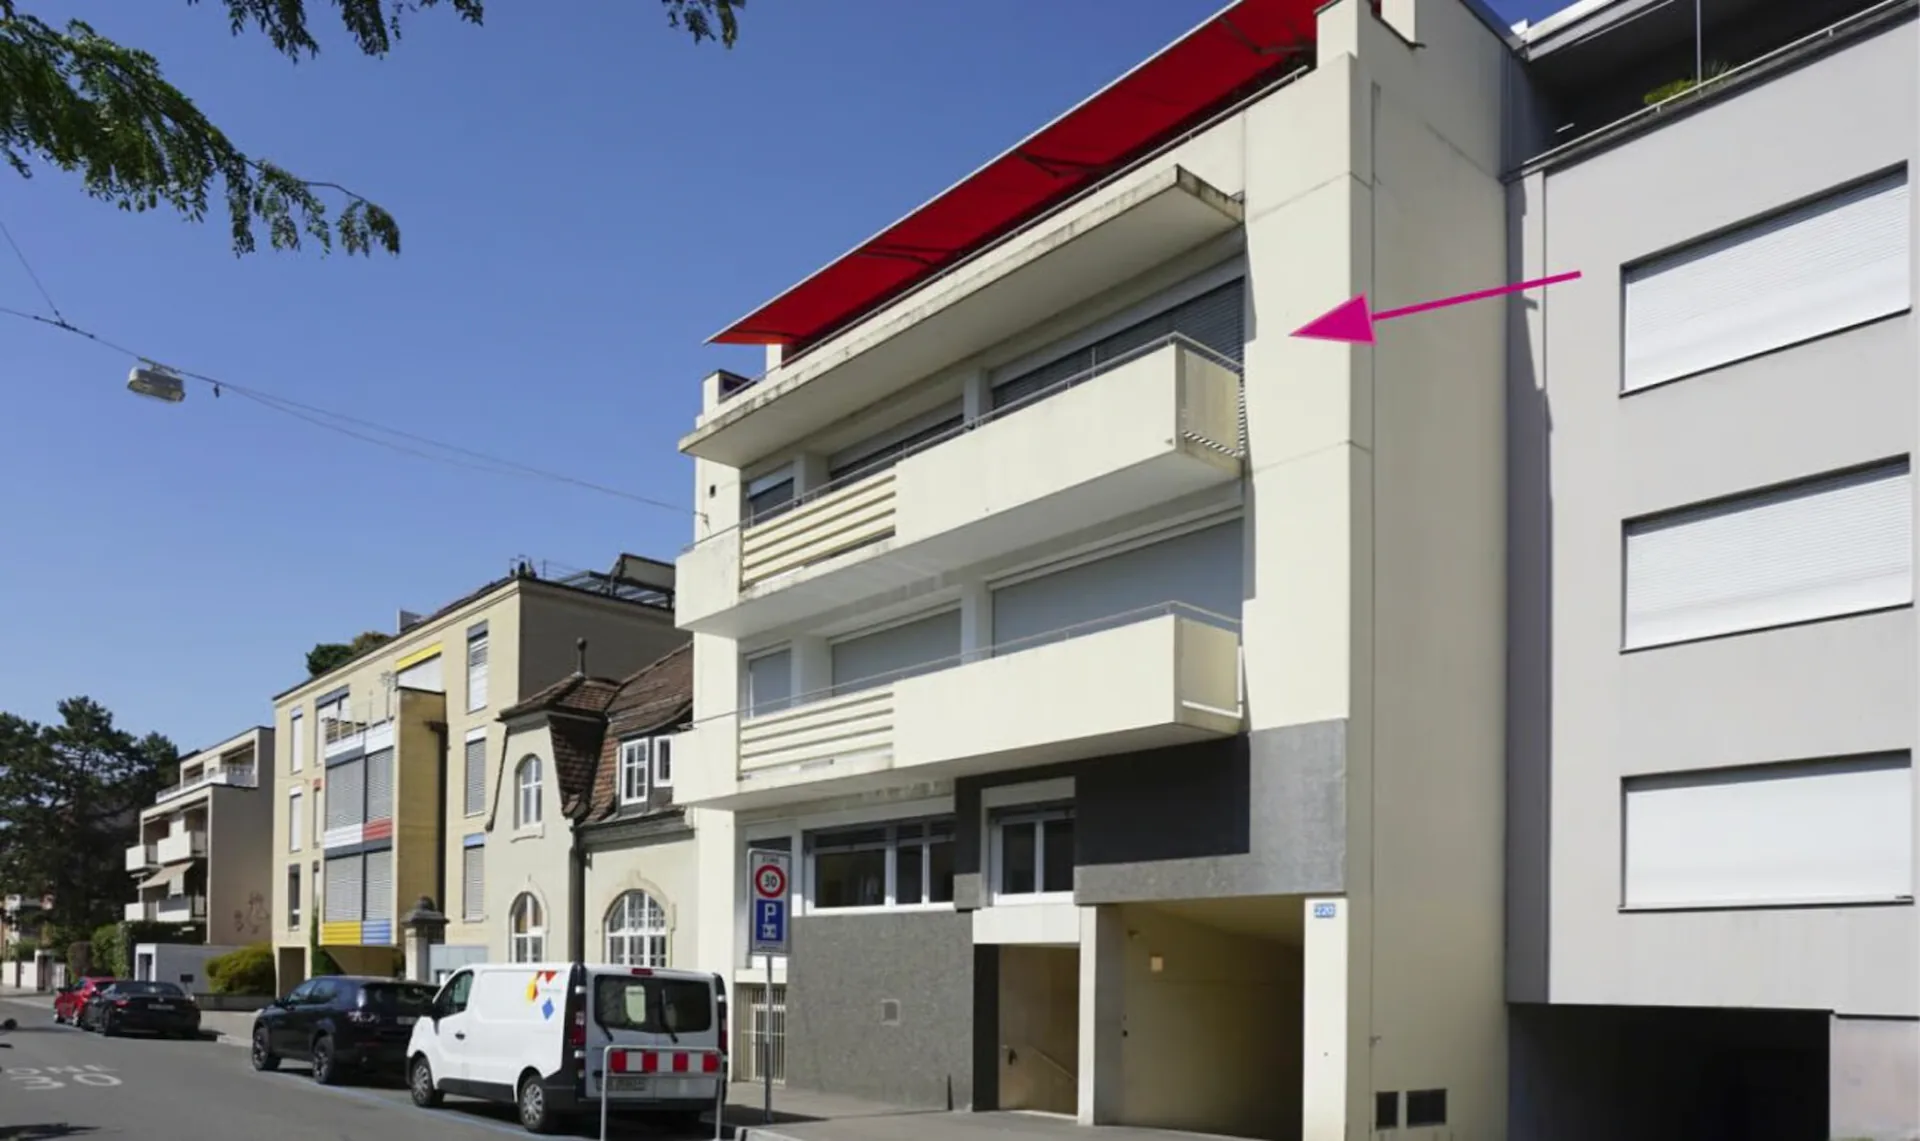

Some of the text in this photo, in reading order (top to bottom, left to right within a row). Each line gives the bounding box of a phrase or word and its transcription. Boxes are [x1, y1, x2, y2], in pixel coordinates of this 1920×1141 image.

[764, 873, 778, 888] 30
[764, 903, 776, 922] P
[5, 1064, 119, 1075] ONE
[10, 1073, 122, 1090] 30
